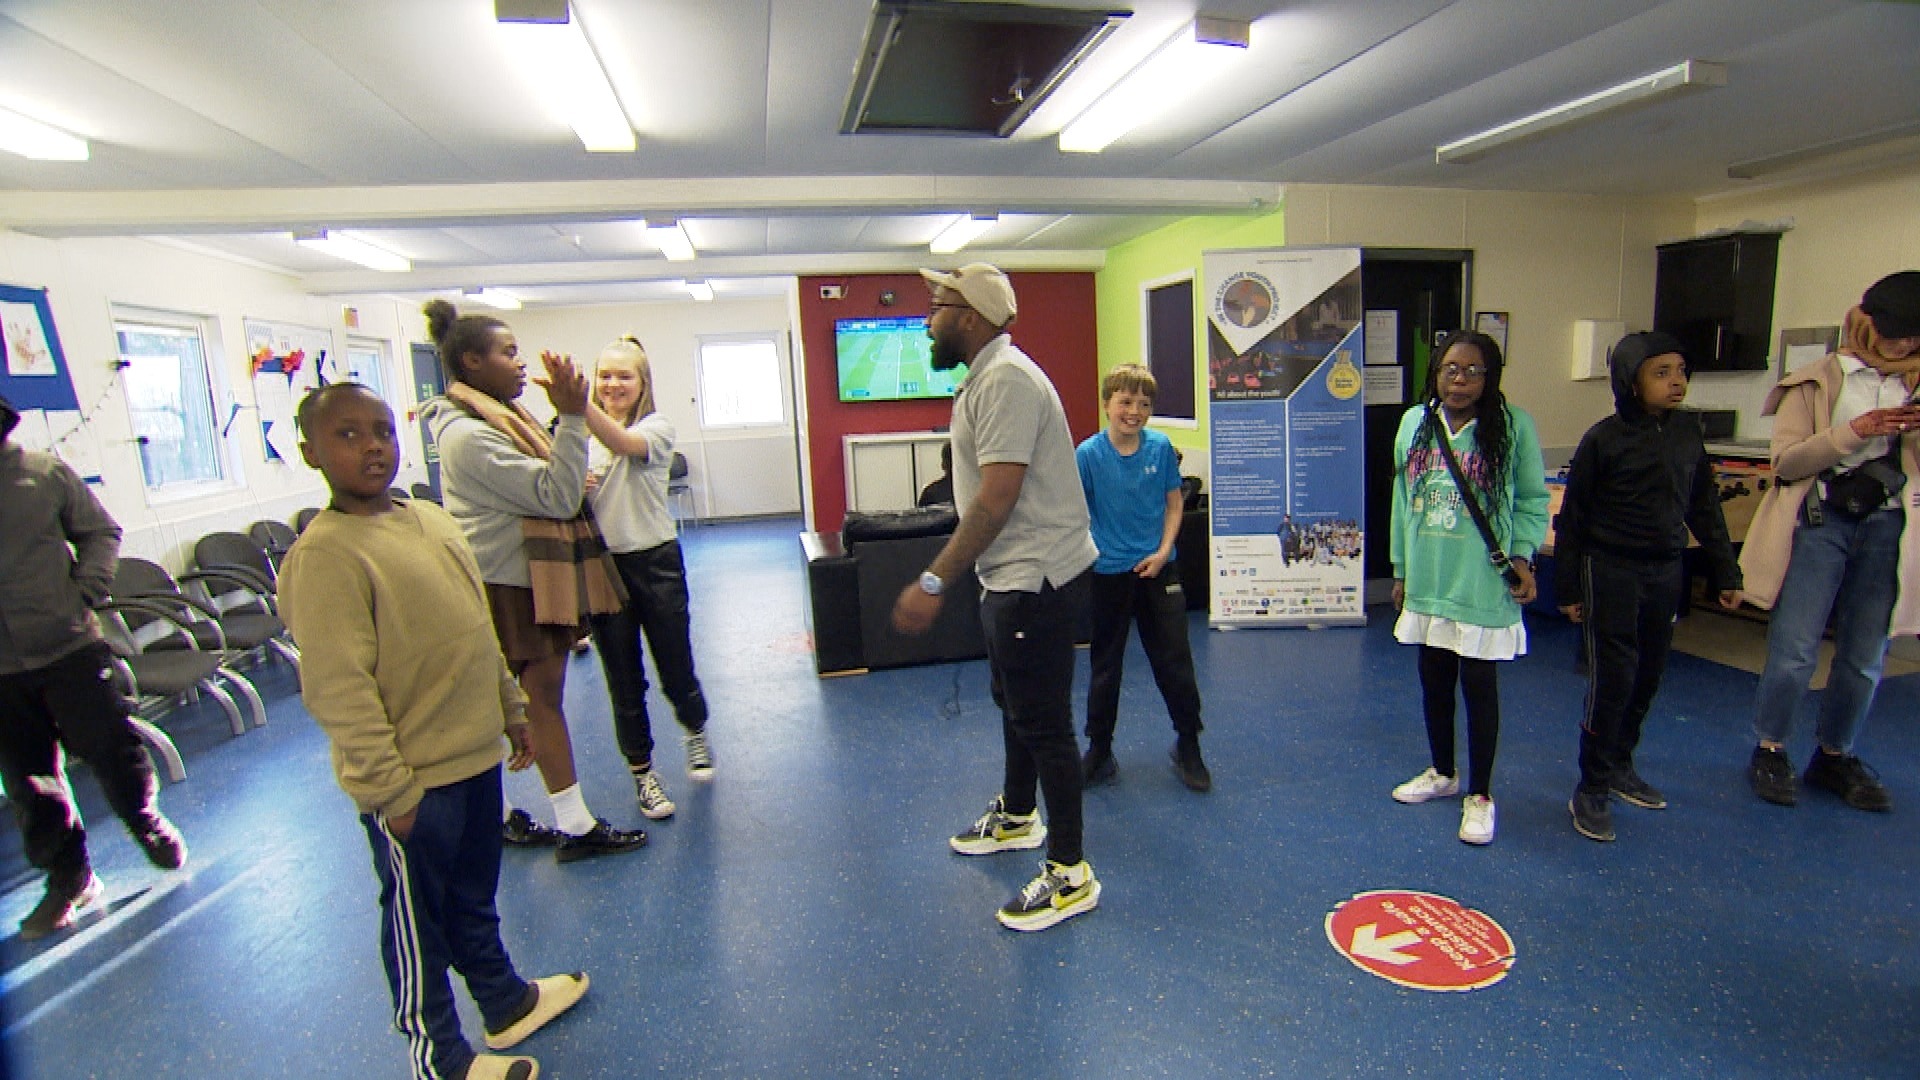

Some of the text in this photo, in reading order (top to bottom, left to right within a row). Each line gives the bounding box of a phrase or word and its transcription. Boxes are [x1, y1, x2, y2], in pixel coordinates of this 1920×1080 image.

[1227, 389, 1247, 399] about
[1381, 901, 1417, 925] safe
[1408, 905, 1479, 954] distance
[1416, 926, 1430, 936] a
[1430, 937, 1477, 971] Keep
